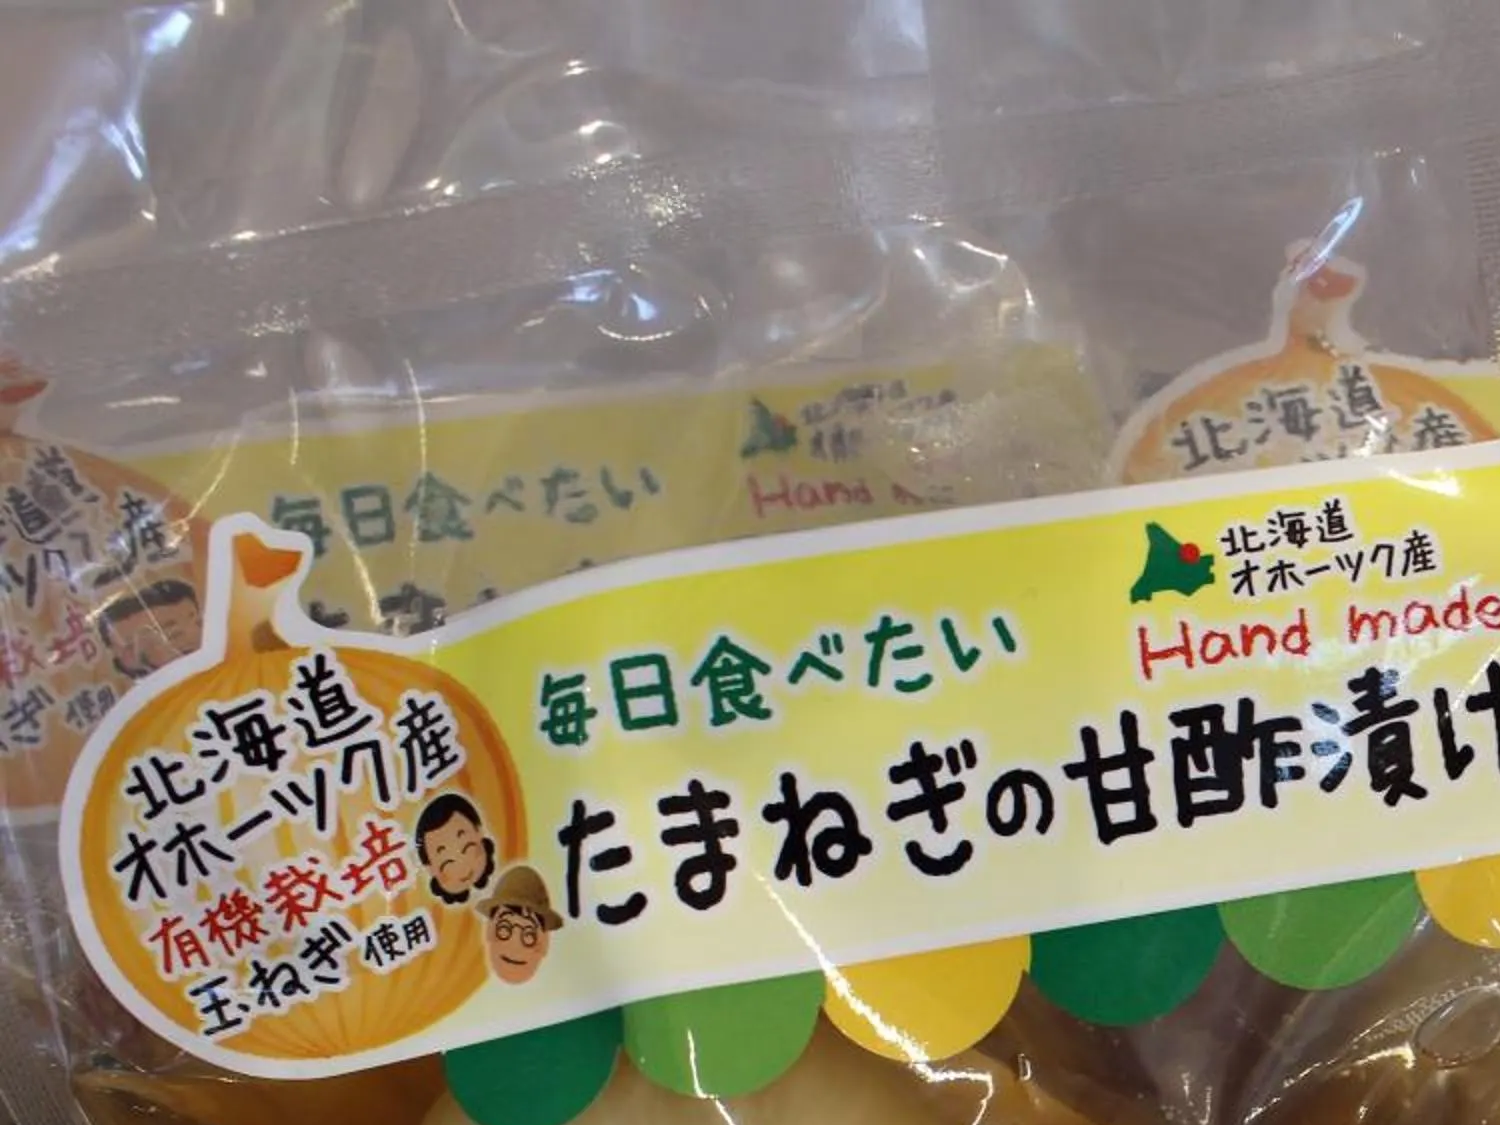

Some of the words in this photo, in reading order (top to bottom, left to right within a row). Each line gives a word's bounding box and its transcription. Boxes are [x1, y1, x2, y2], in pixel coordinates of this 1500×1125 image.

[1172, 365, 1387, 470] 北海道
[1221, 499, 1353, 554] 北海道
[1231, 529, 1437, 597] オホーツク産
[538, 614, 1016, 747] 毎日食べたい
[1138, 608, 1310, 680] Hand
[126, 654, 373, 820] 北海道
[115, 698, 459, 901] オホーツク産
[149, 820, 407, 973] 有機栽培
